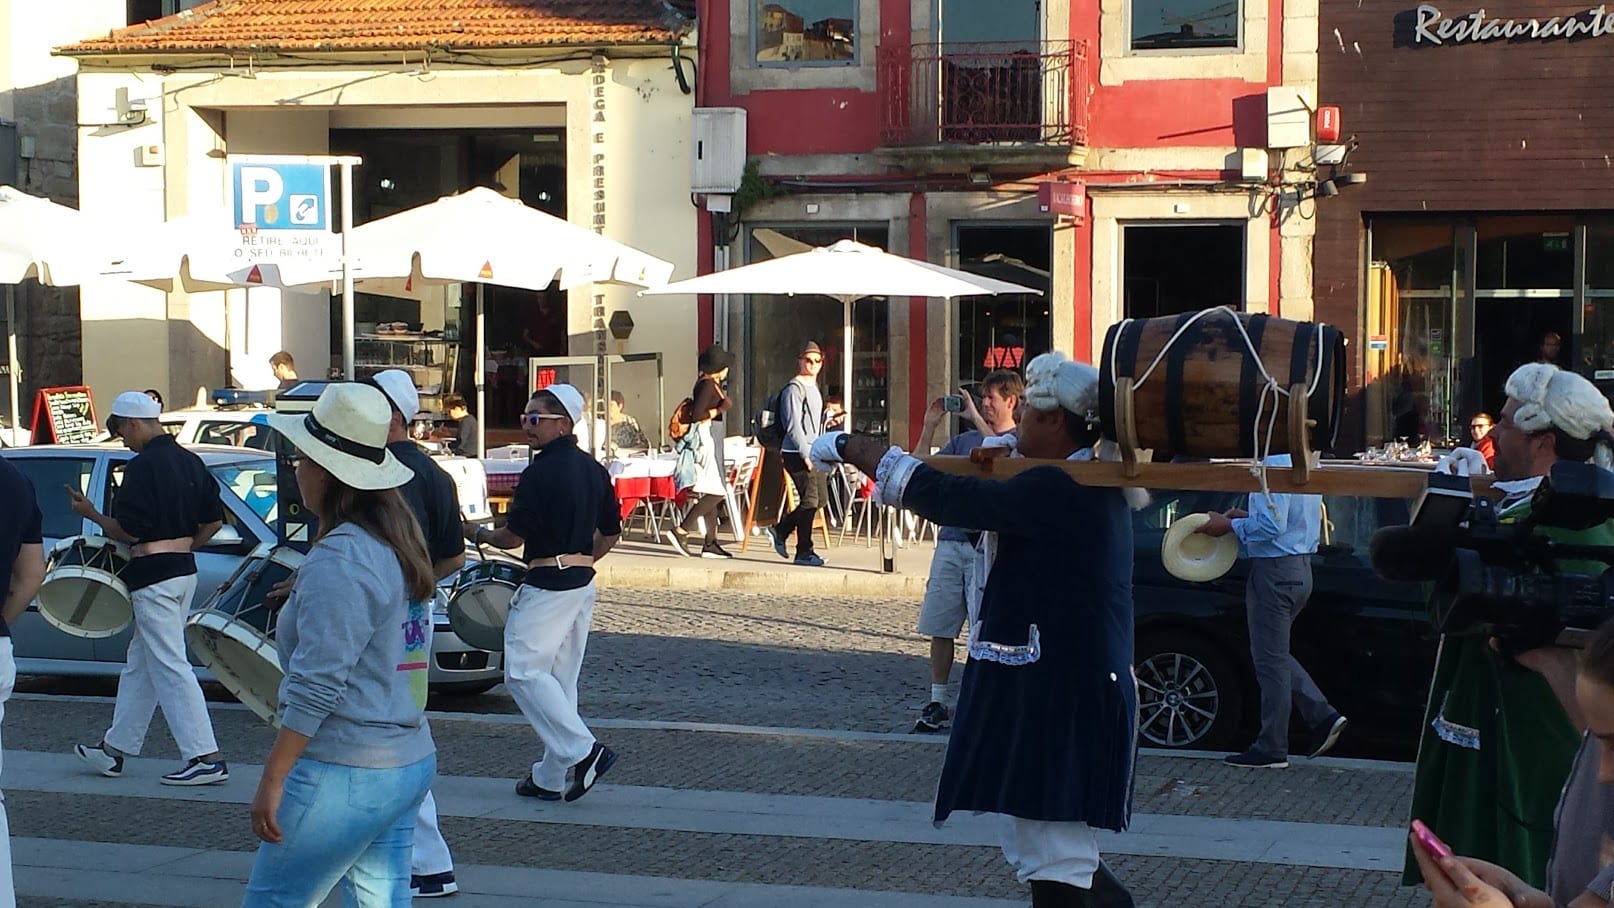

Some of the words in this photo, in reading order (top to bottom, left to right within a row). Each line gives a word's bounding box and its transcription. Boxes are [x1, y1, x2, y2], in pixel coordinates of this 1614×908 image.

[1415, 4, 1614, 45] Restaurante
[593, 132, 605, 143] E
[240, 165, 284, 223] P
[592, 153, 606, 237] PRESUNT
[234, 247, 243, 258] O
